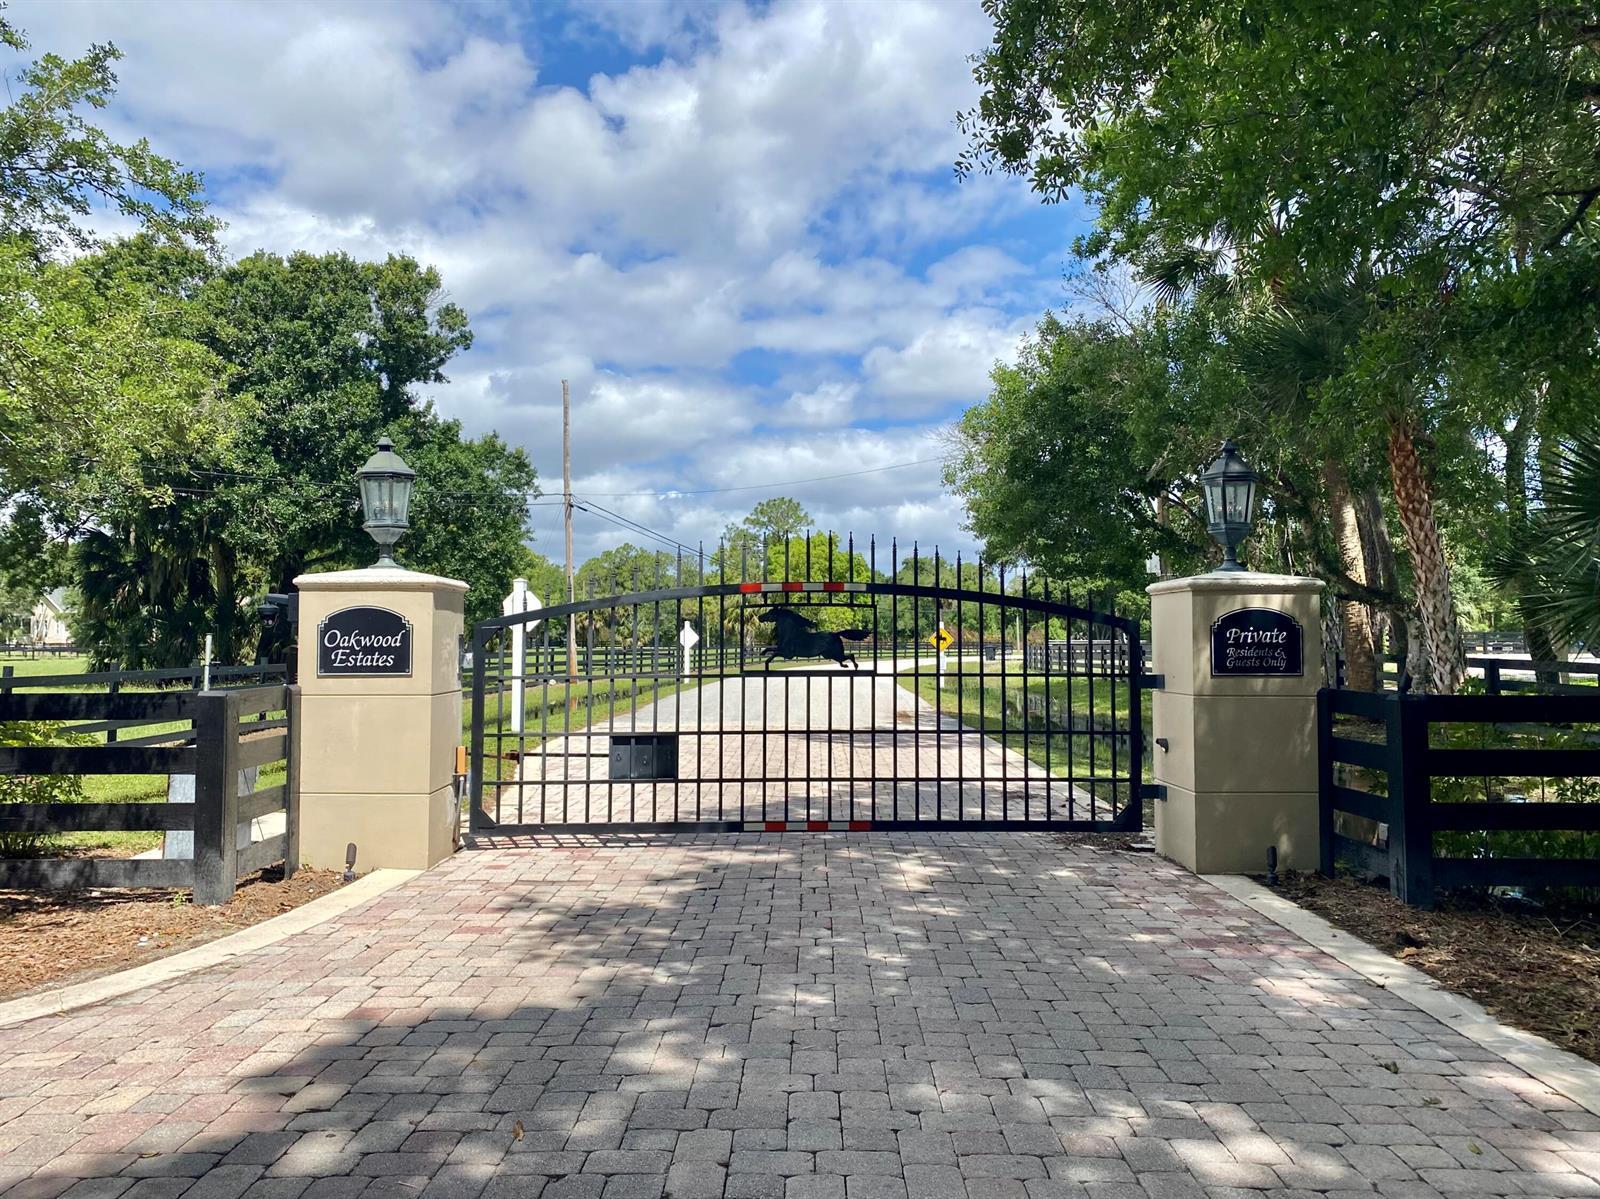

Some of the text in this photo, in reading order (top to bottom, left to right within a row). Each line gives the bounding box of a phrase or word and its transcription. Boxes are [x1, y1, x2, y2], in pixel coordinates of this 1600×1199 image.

[324, 629, 406, 650] Oakwood
[1226, 627, 1287, 643] Private
[331, 648, 395, 667] Estates
[1226, 646, 1287, 659] Residents &
[1226, 657, 1287, 670] Guests Only
